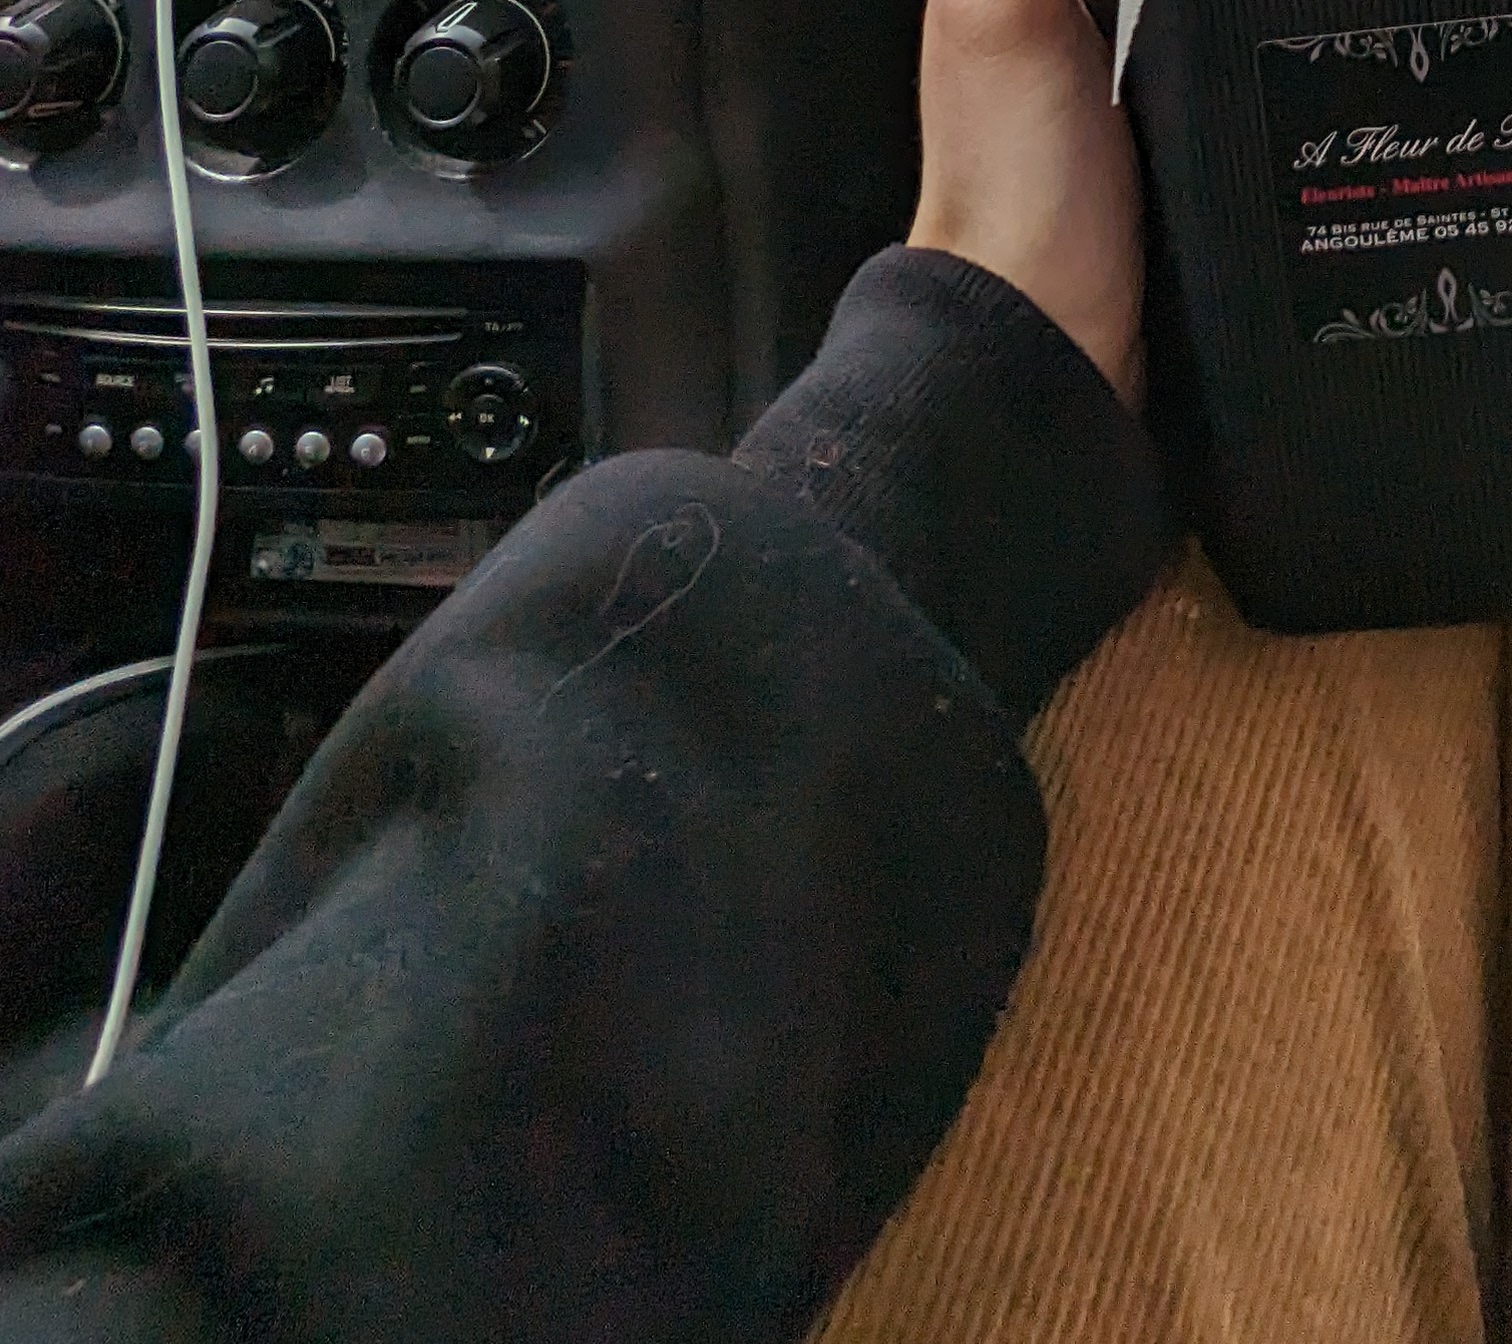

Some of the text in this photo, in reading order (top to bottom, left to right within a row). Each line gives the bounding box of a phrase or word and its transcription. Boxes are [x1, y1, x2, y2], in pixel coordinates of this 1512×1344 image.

[1293, 130, 1338, 169] A
[1341, 124, 1439, 165] Fleur
[1446, 118, 1485, 153] de
[1301, 227, 1430, 253] ANGOULÊME
[1434, 224, 1460, 240] 05
[1464, 221, 1489, 235] 45
[1307, 225, 1327, 237] 74
